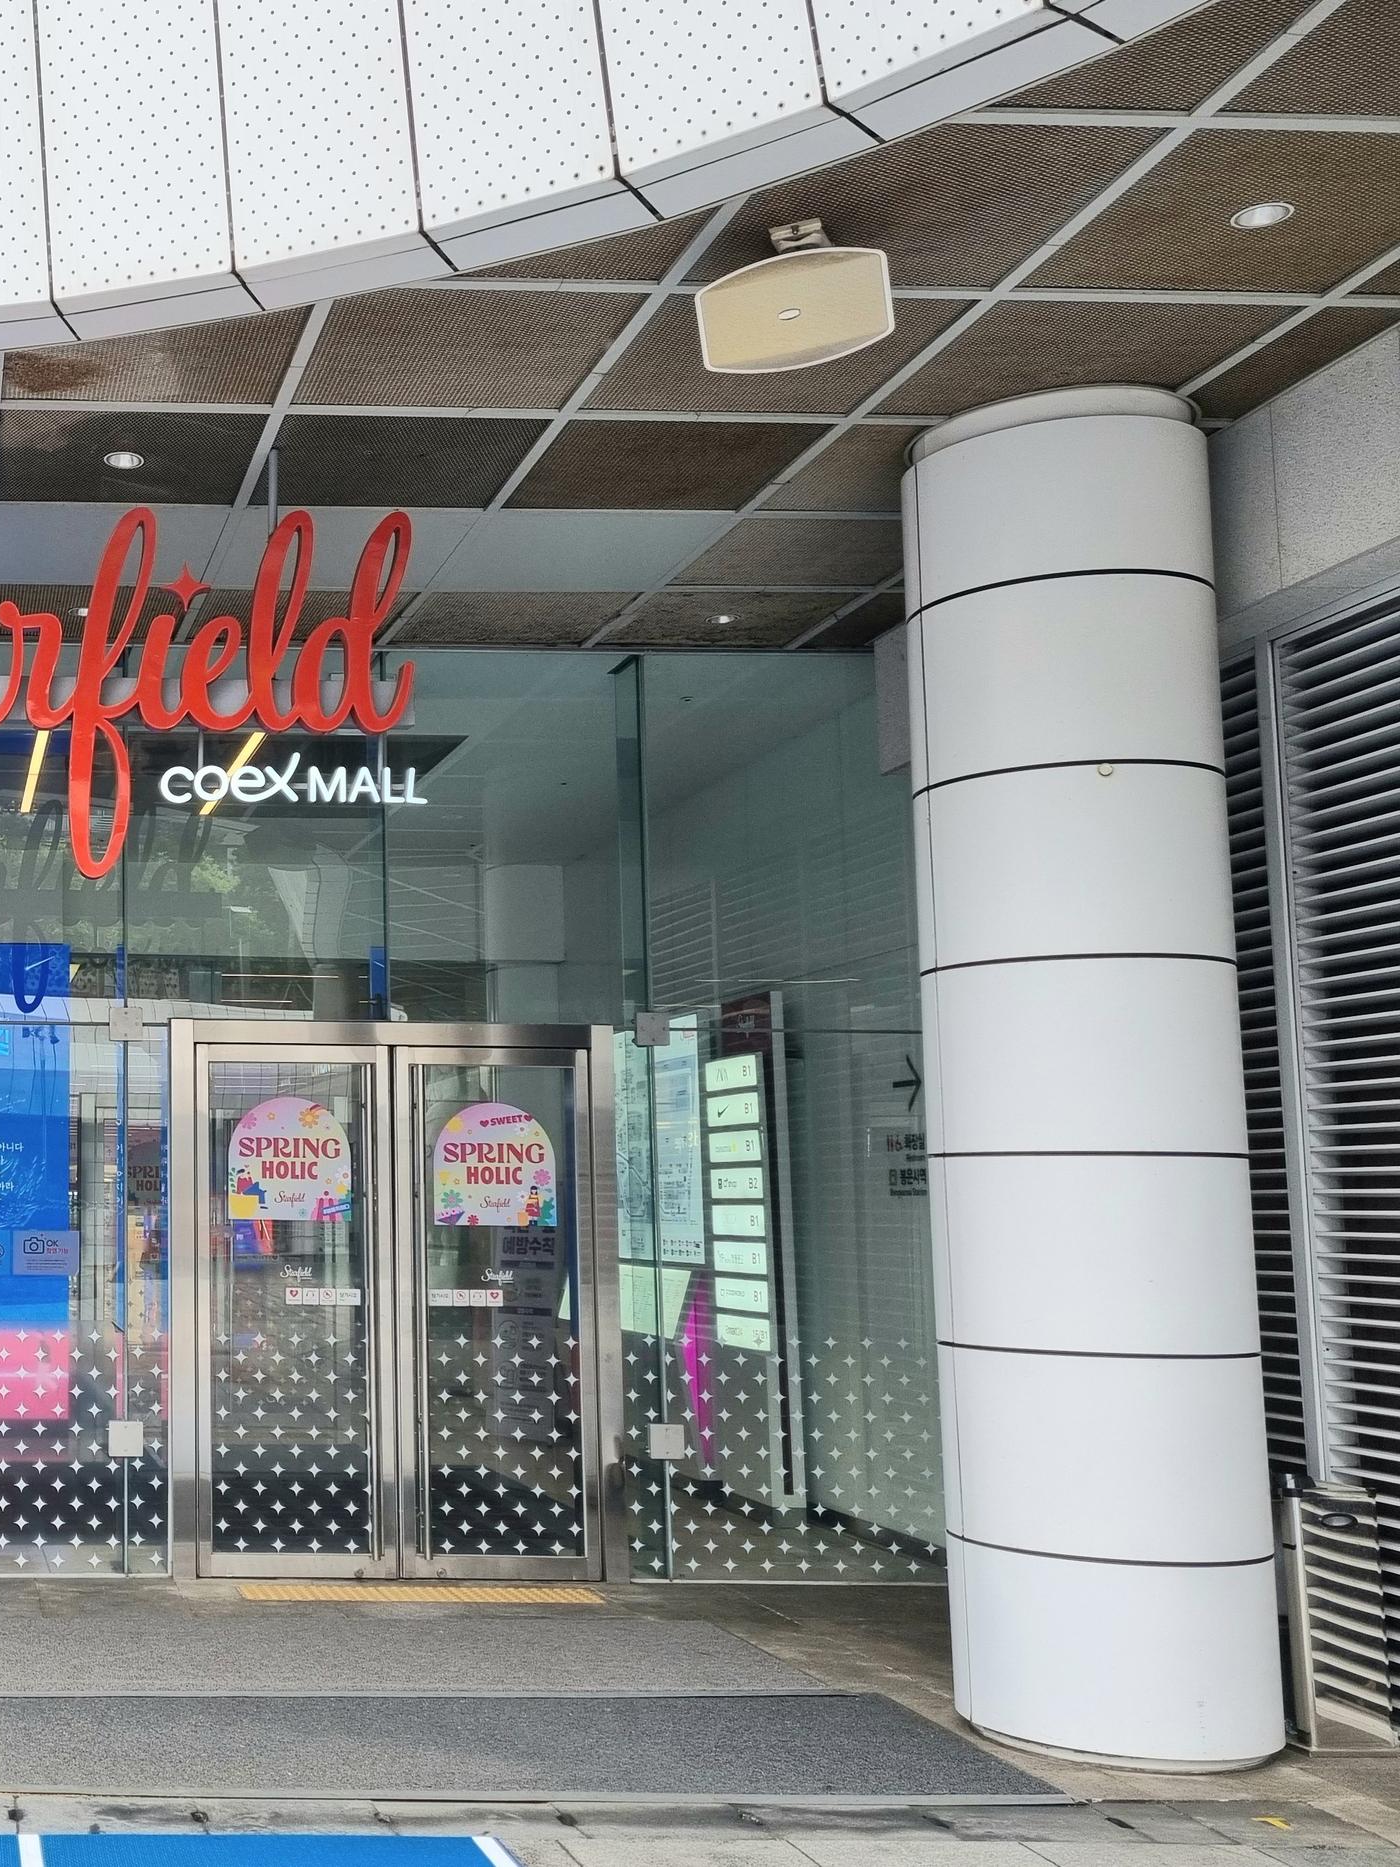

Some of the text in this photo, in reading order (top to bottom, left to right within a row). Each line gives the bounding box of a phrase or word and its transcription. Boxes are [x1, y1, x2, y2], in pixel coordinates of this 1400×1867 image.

[307, 765, 428, 804] MALL
[742, 1065, 751, 1077] B1
[744, 1102, 753, 1114] B1
[490, 1114, 523, 1126] SWEET
[238, 1137, 341, 1159] SPRING
[745, 1139, 755, 1151] B1
[443, 1142, 545, 1164] SPRING
[261, 1161, 318, 1180] HOLIC
[466, 1166, 523, 1185] HOLIC
[900, 1168, 927, 1185] 봉은사역
[748, 1177, 758, 1189] B2
[274, 1191, 306, 1208] Starfield
[480, 1195, 511, 1213] Starfield
[750, 1215, 759, 1226] B1
[46, 1239, 59, 1247] OK
[503, 1236, 555, 1256] 예방수칙
[752, 1252, 761, 1264] B1
[753, 1290, 762, 1303] B1
